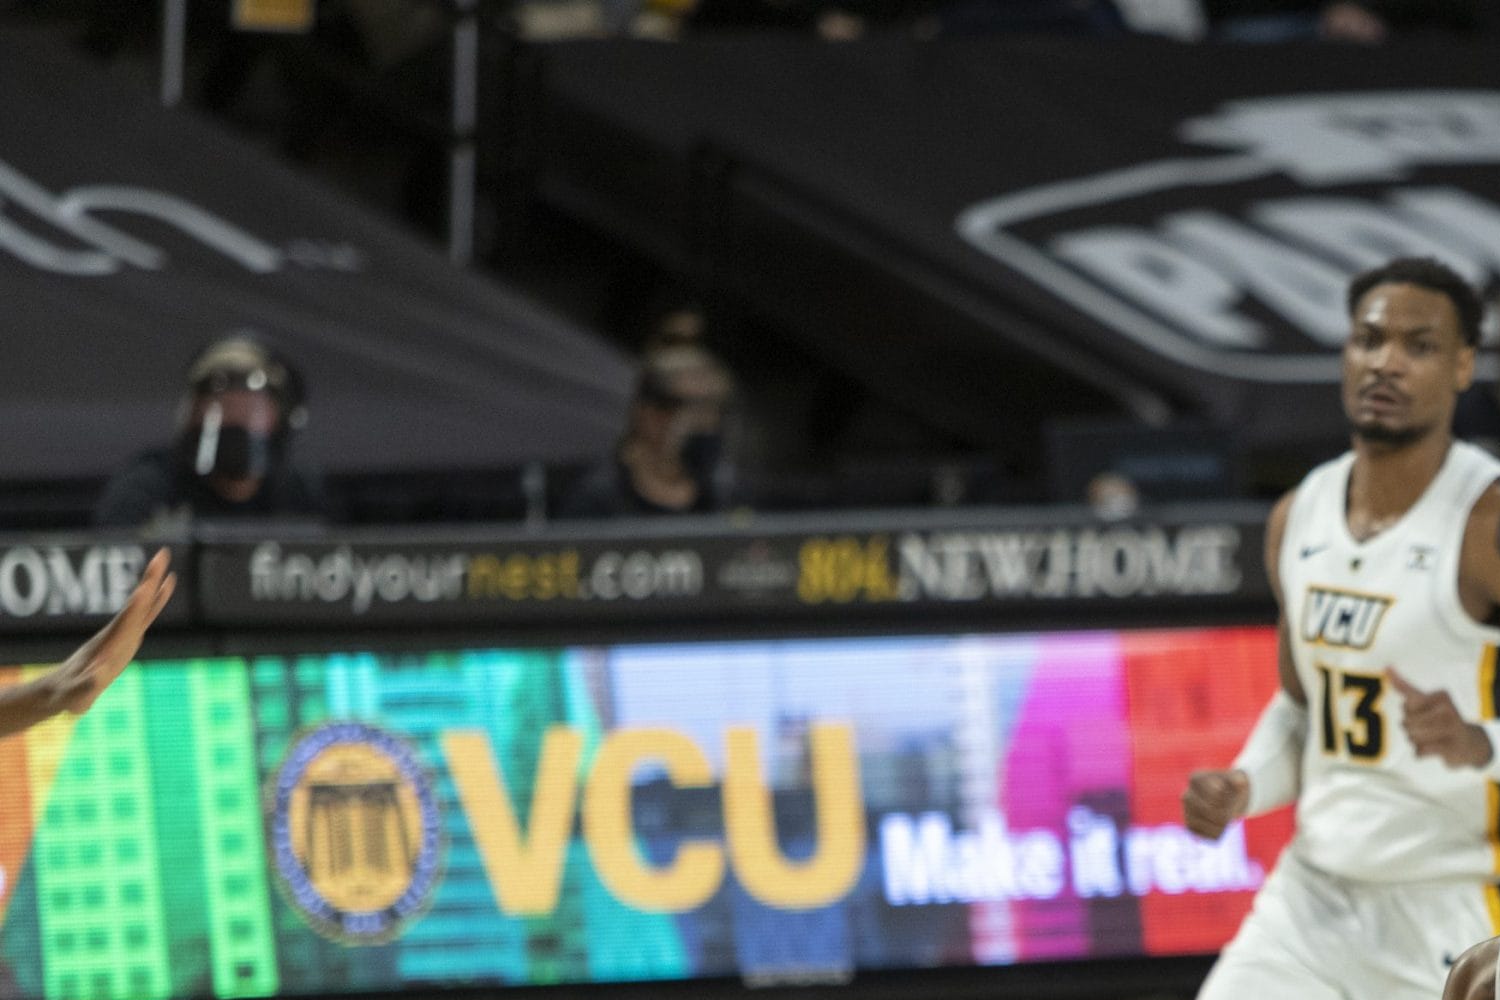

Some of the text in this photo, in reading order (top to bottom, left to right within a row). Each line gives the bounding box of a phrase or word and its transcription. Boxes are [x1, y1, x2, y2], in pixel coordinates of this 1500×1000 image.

[249, 539, 705, 613] findyournest.com
[1304, 584, 1392, 650] VCU
[1317, 664, 1388, 764] 13
[440, 721, 868, 917] VCU
[880, 810, 1064, 906] Make
[1067, 804, 1124, 898] it
